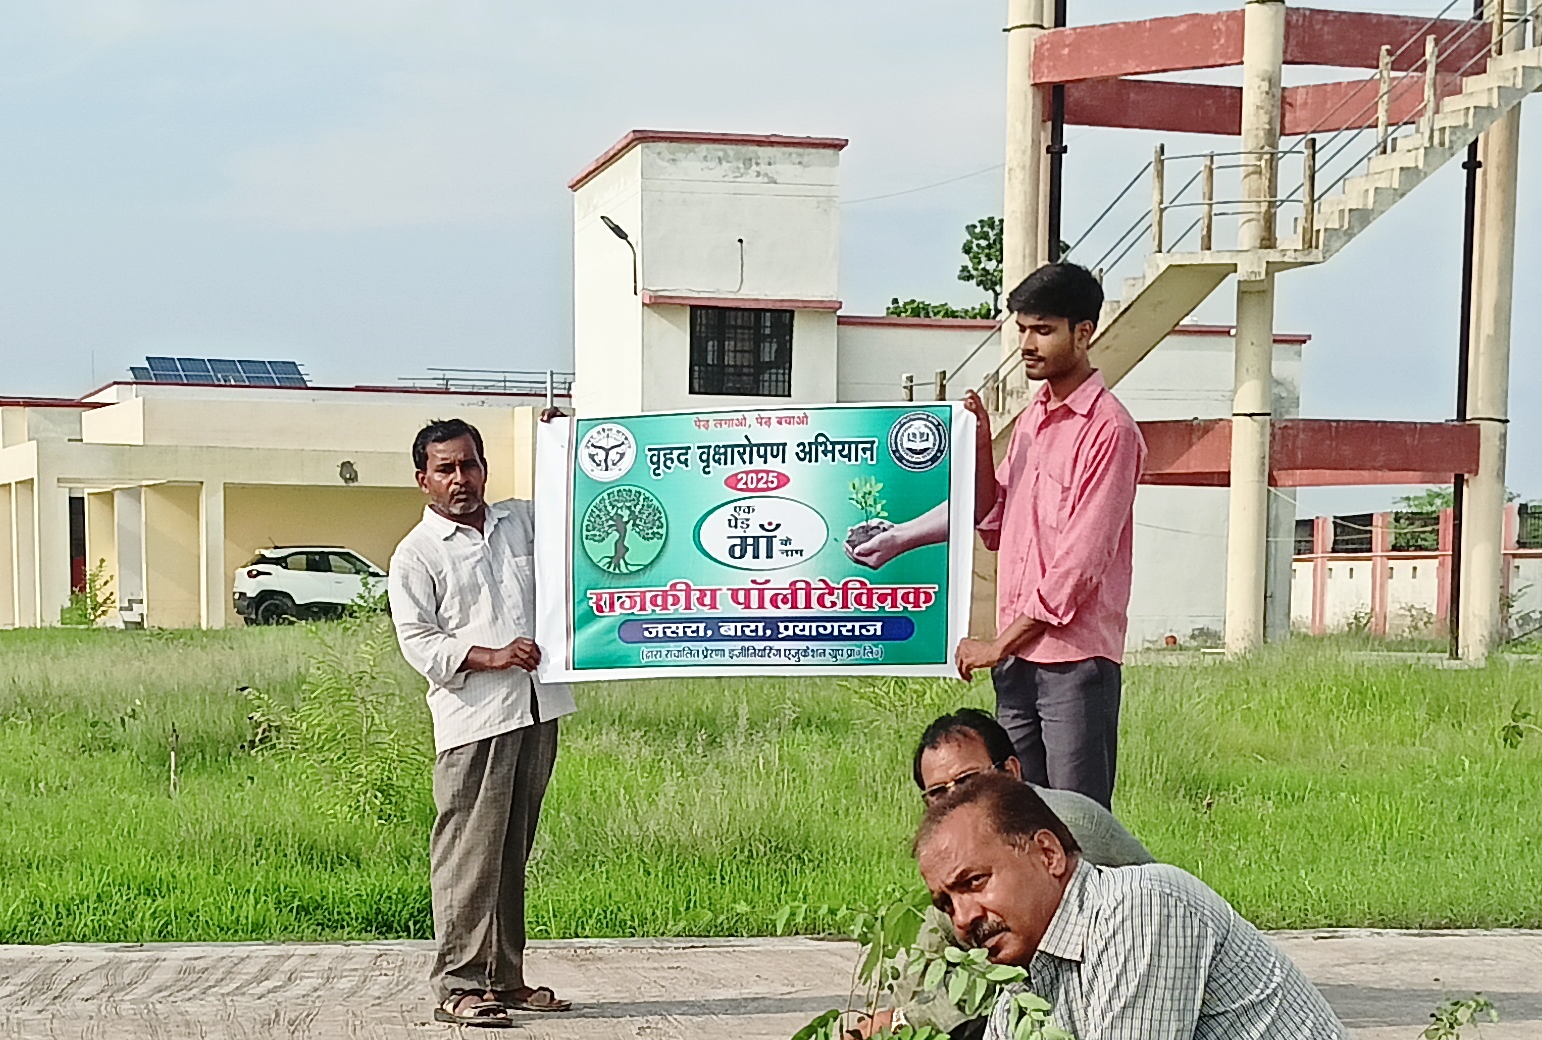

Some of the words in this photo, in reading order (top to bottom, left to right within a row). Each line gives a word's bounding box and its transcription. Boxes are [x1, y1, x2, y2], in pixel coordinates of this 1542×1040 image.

[647, 445, 691, 476] वृहद
[697, 435, 787, 475] वृक्षारोपण
[795, 432, 876, 464] अभियान
[736, 472, 778, 489] 2025
[733, 505, 756, 516] एक
[727, 513, 751, 533] पेड़
[726, 520, 782, 560] माँ
[589, 581, 723, 614] राजकीय
[727, 578, 937, 611] पॉलीटेक्निक
[642, 622, 713, 638] जसरा,
[718, 621, 772, 637] बारा,
[777, 621, 883, 639] प्रयागराज
